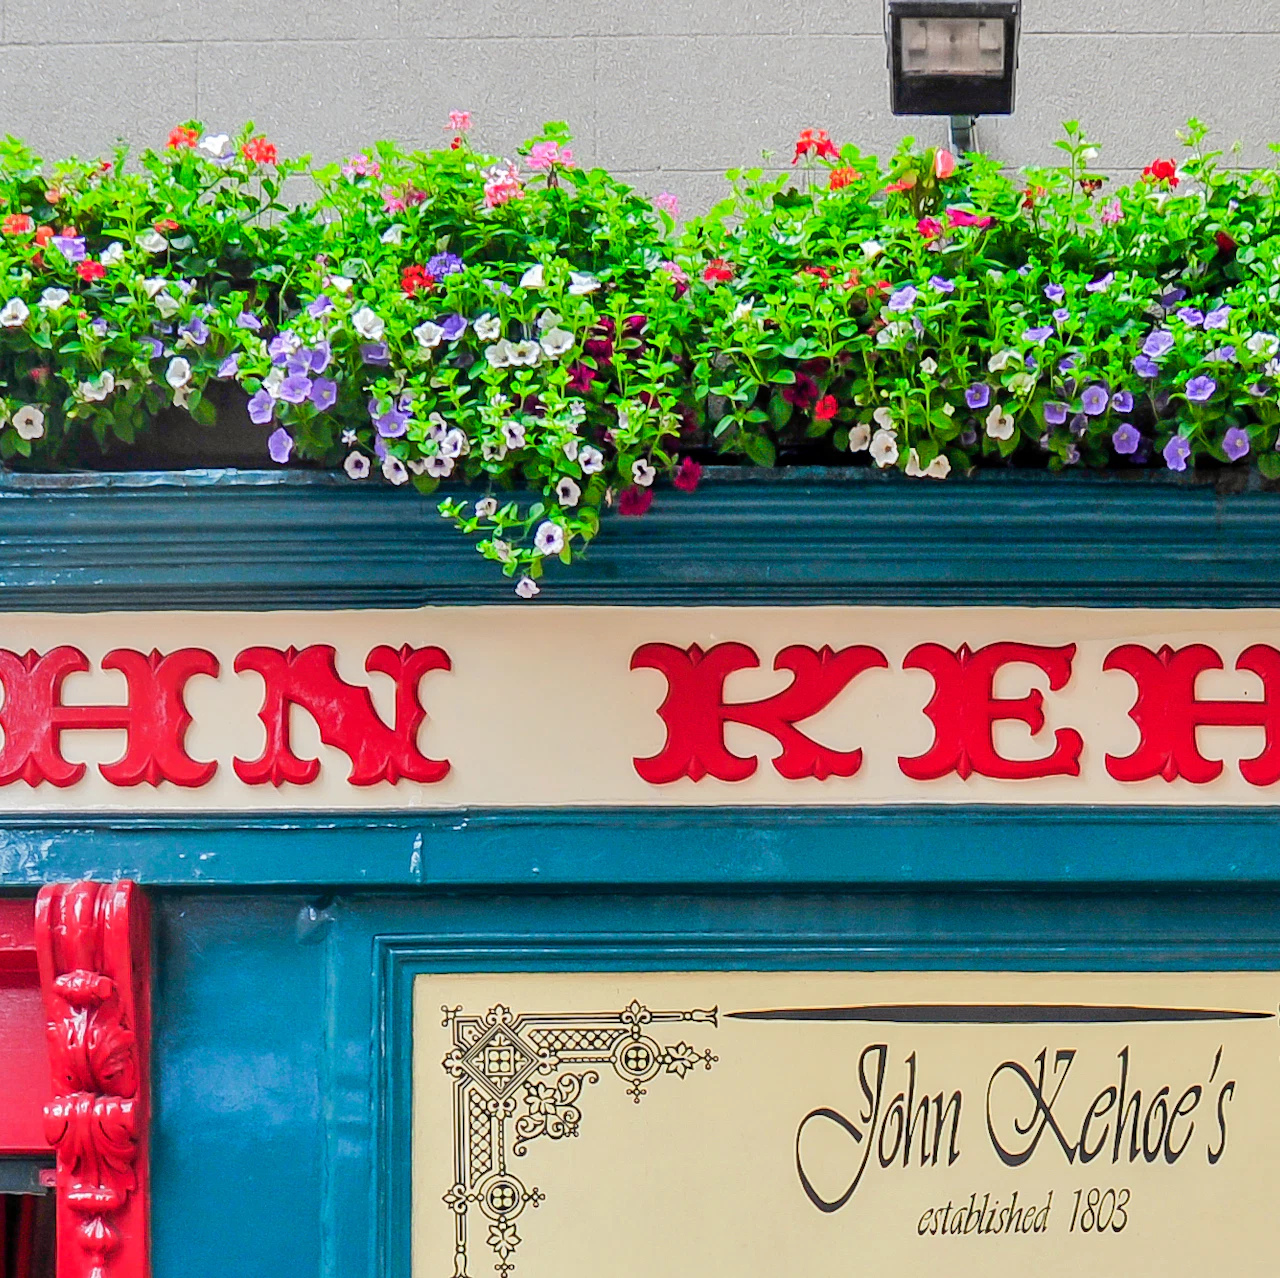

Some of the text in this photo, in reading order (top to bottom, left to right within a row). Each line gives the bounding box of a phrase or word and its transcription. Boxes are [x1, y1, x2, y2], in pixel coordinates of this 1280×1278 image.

[795, 1044, 1236, 1214] John Kehoe's
[917, 1187, 1131, 1236] established 1803
